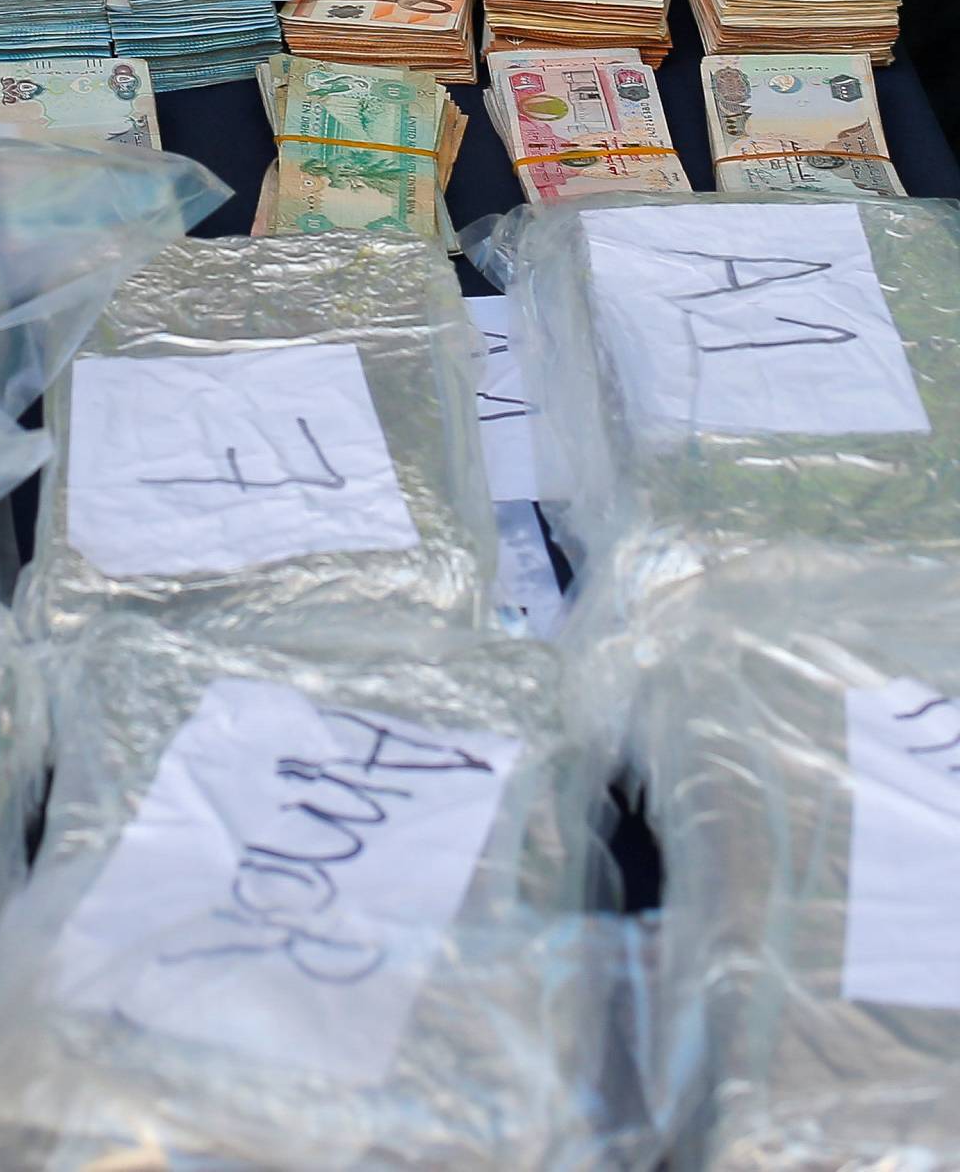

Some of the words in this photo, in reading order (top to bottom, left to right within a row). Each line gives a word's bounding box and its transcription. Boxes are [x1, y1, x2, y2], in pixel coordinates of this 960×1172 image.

[389, 86, 400, 97] 10
[302, 100, 312, 114] TEN
[308, 218, 321, 229] 10
[656, 248, 859, 354] A1
